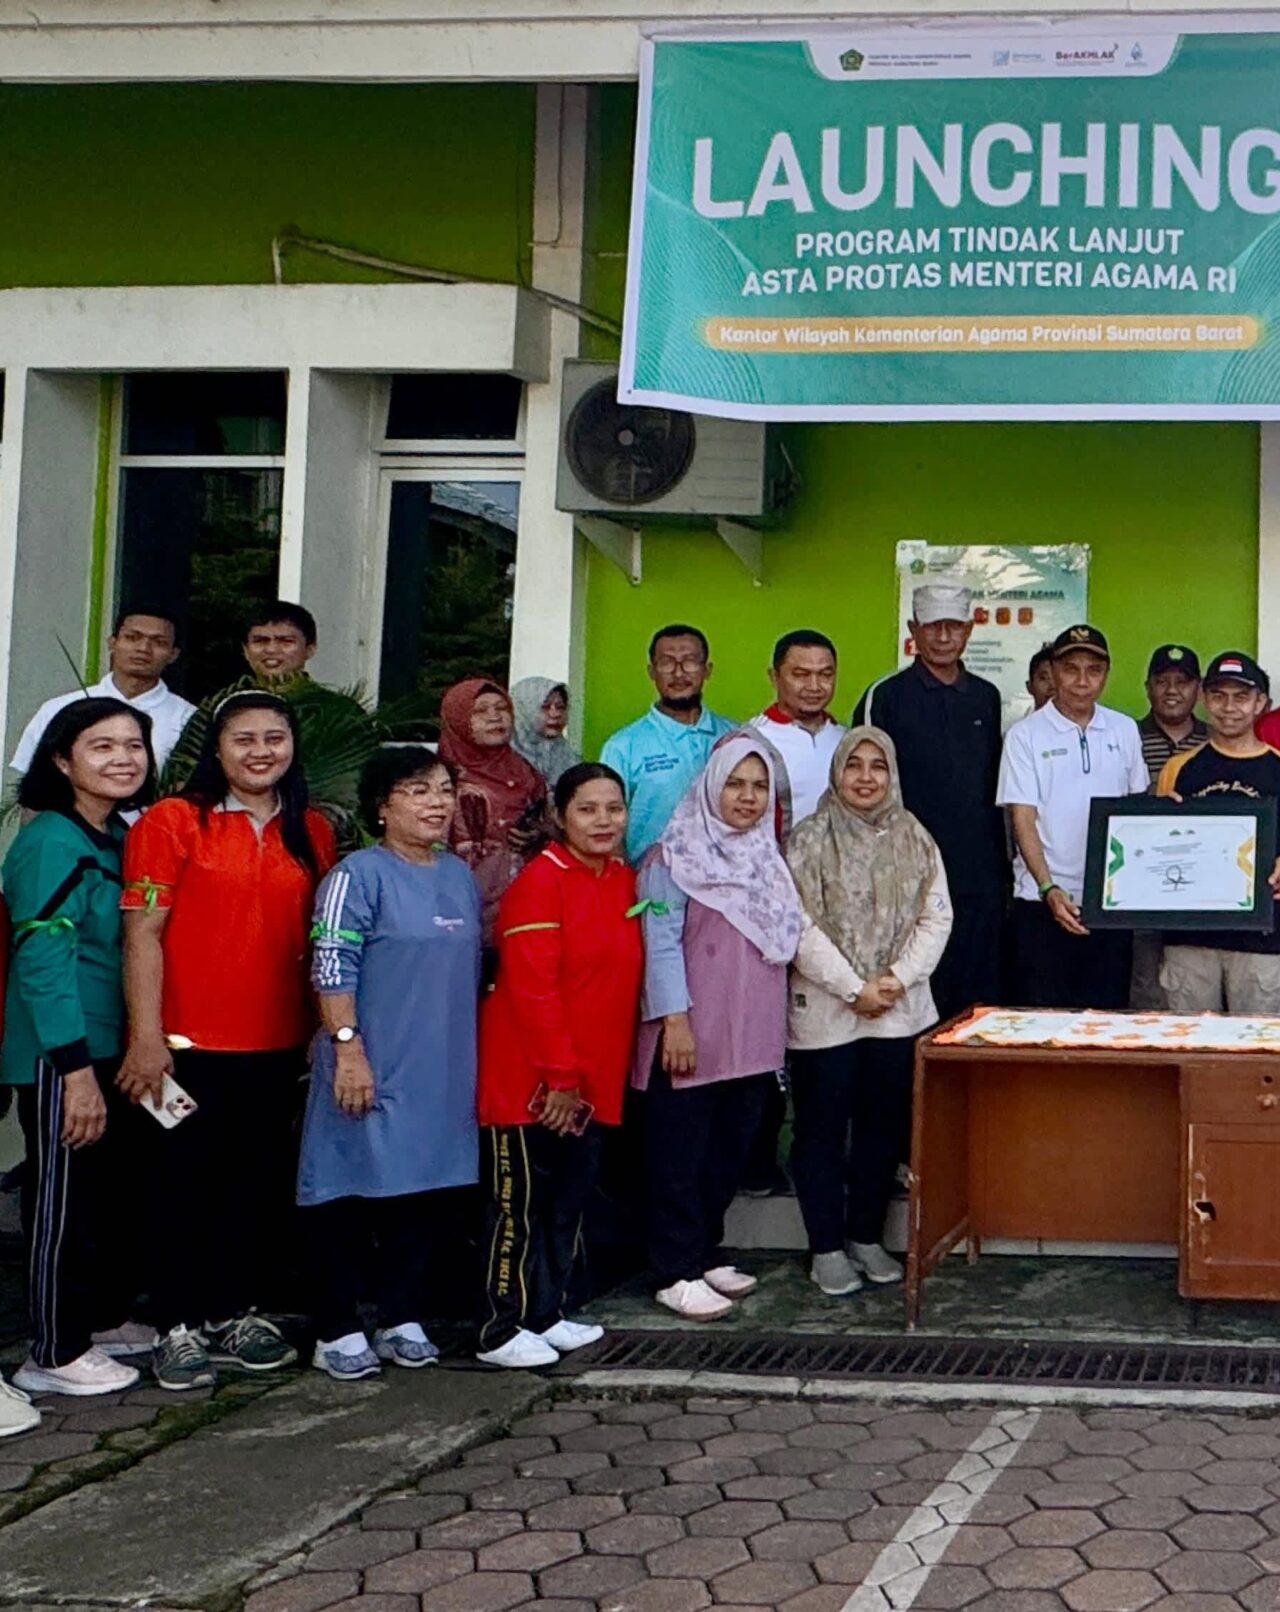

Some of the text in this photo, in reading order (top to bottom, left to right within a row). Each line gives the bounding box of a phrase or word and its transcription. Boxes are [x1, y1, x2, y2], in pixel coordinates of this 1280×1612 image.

[797, 227, 1184, 258] PROGRAM TINDAK LANJUT
[742, 262, 1236, 296] ASTA PROTAS MENTERI AGAMA RI
[720, 324, 1244, 346] Kantor Wilayah Kementerian Agama Provinsi Sumatera Barat
